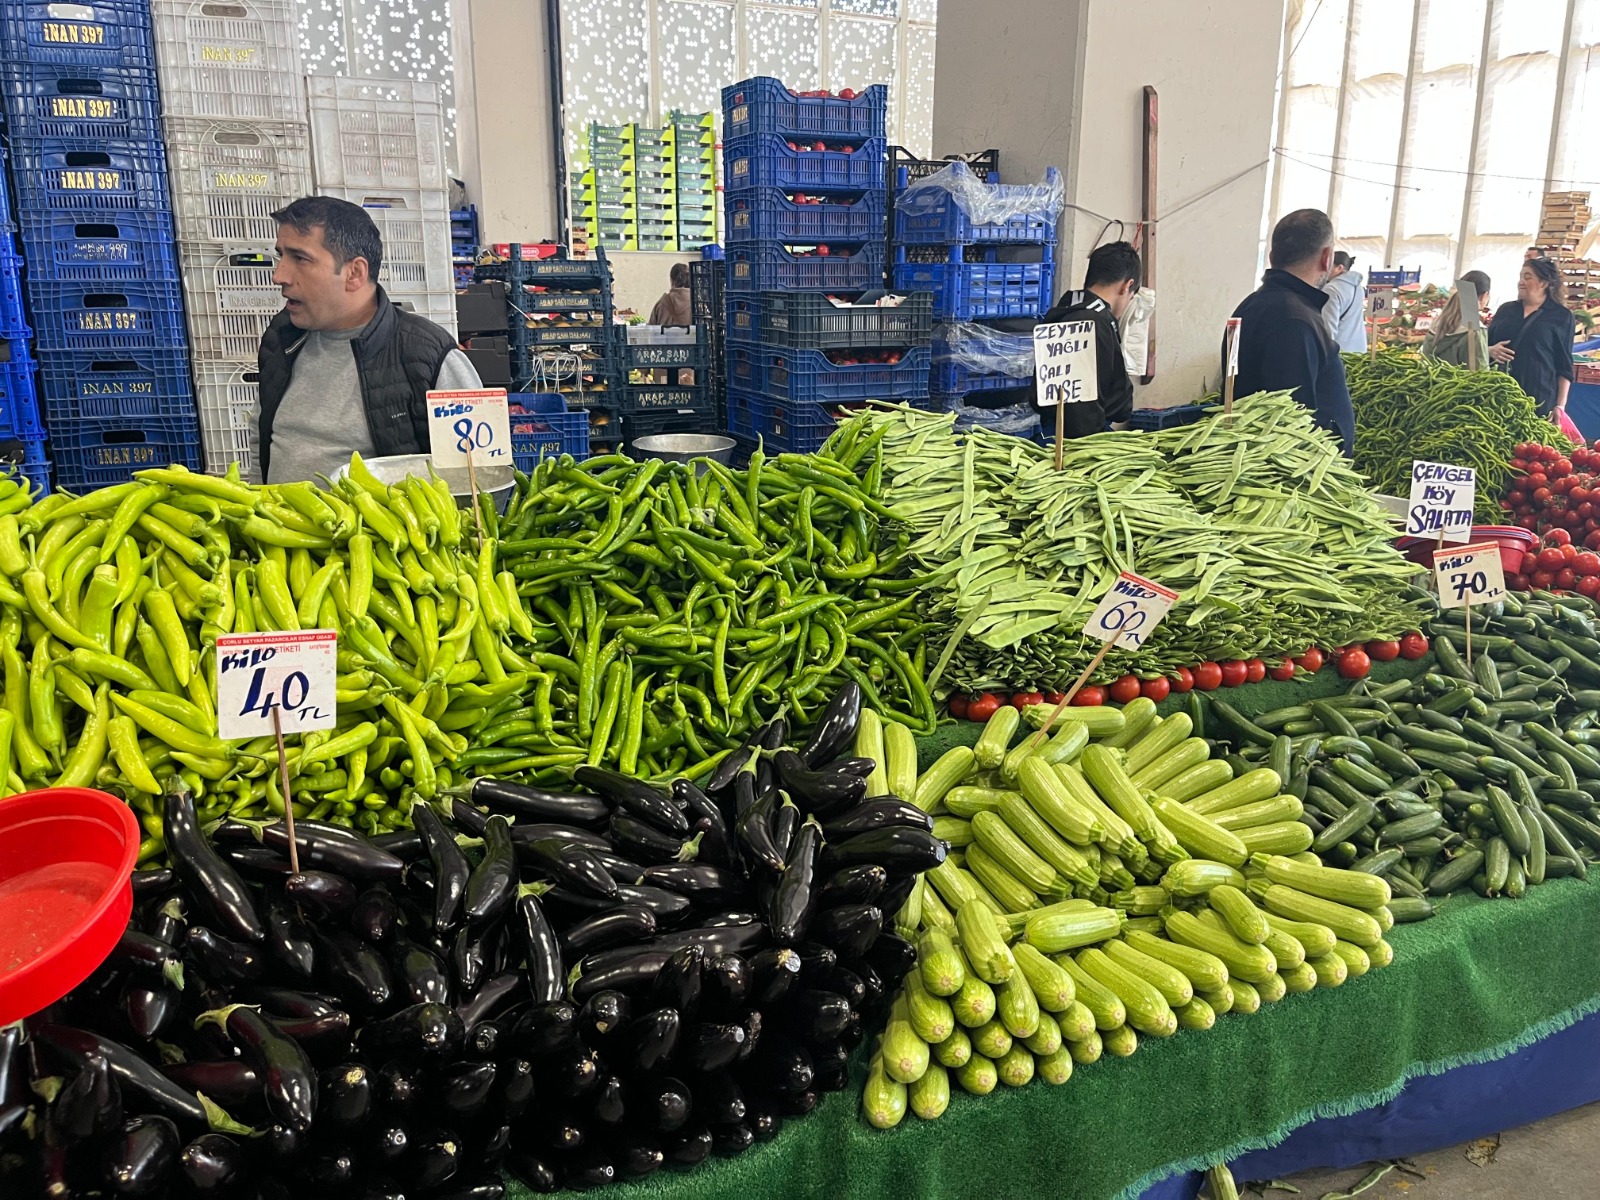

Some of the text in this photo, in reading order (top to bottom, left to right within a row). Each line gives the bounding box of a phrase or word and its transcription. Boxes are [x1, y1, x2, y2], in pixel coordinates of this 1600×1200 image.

[81, 25, 104, 44] 397
[89, 100, 111, 118] 397
[98, 172, 119, 189] 397
[248, 175, 268, 187] 397
[115, 312, 136, 330] 397
[637, 350, 663, 359] ARAP
[1040, 364, 1071, 383] ÇALI
[129, 382, 152, 393] 397
[639, 392, 664, 402] ARAP
[453, 418, 494, 453] 80
[133, 447, 154, 462] 397
[487, 449, 507, 458] TL
[511, 442, 560, 453] NAN 397
[1413, 463, 1473, 483] ÇENGEL
[1422, 485, 1456, 506] KÖY
[1409, 505, 1472, 534] SALATA
[1451, 571, 1487, 601] 70
[1485, 587, 1504, 598] TL
[1100, 601, 1146, 632] 60
[274, 644, 301, 653] ETİKETİ
[239, 667, 310, 718] 40
[297, 706, 331, 721] TL
